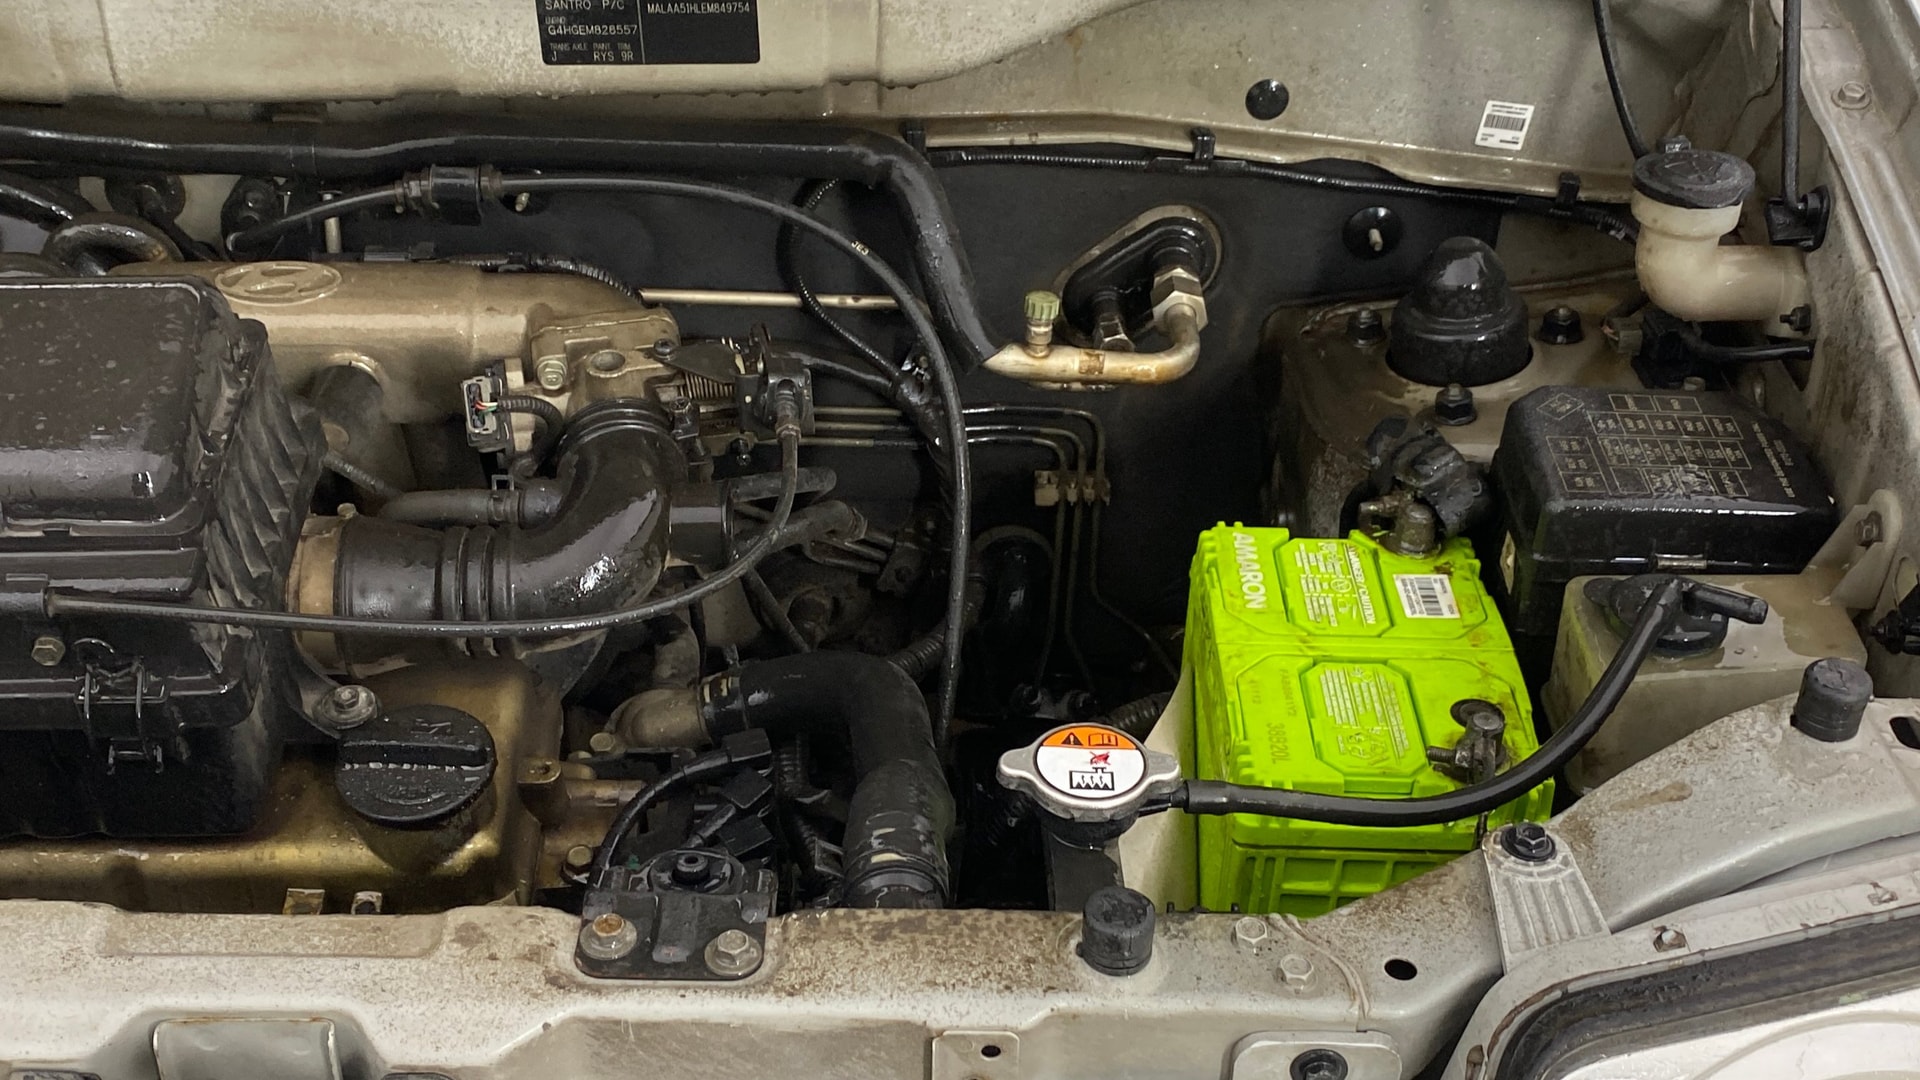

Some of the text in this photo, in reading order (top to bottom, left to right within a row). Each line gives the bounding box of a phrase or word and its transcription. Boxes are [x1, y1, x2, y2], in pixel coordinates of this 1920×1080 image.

[545, 0, 625, 11] SANTRO P/C
[647, 2, 750, 15] MALAA51HLEM849754
[548, 24, 638, 36] G4HGEM828557
[593, 51, 615, 61] RYS
[620, 51, 634, 61] 9R
[1232, 532, 1267, 609] AMARON
[1265, 721, 1292, 765] 38B20L
